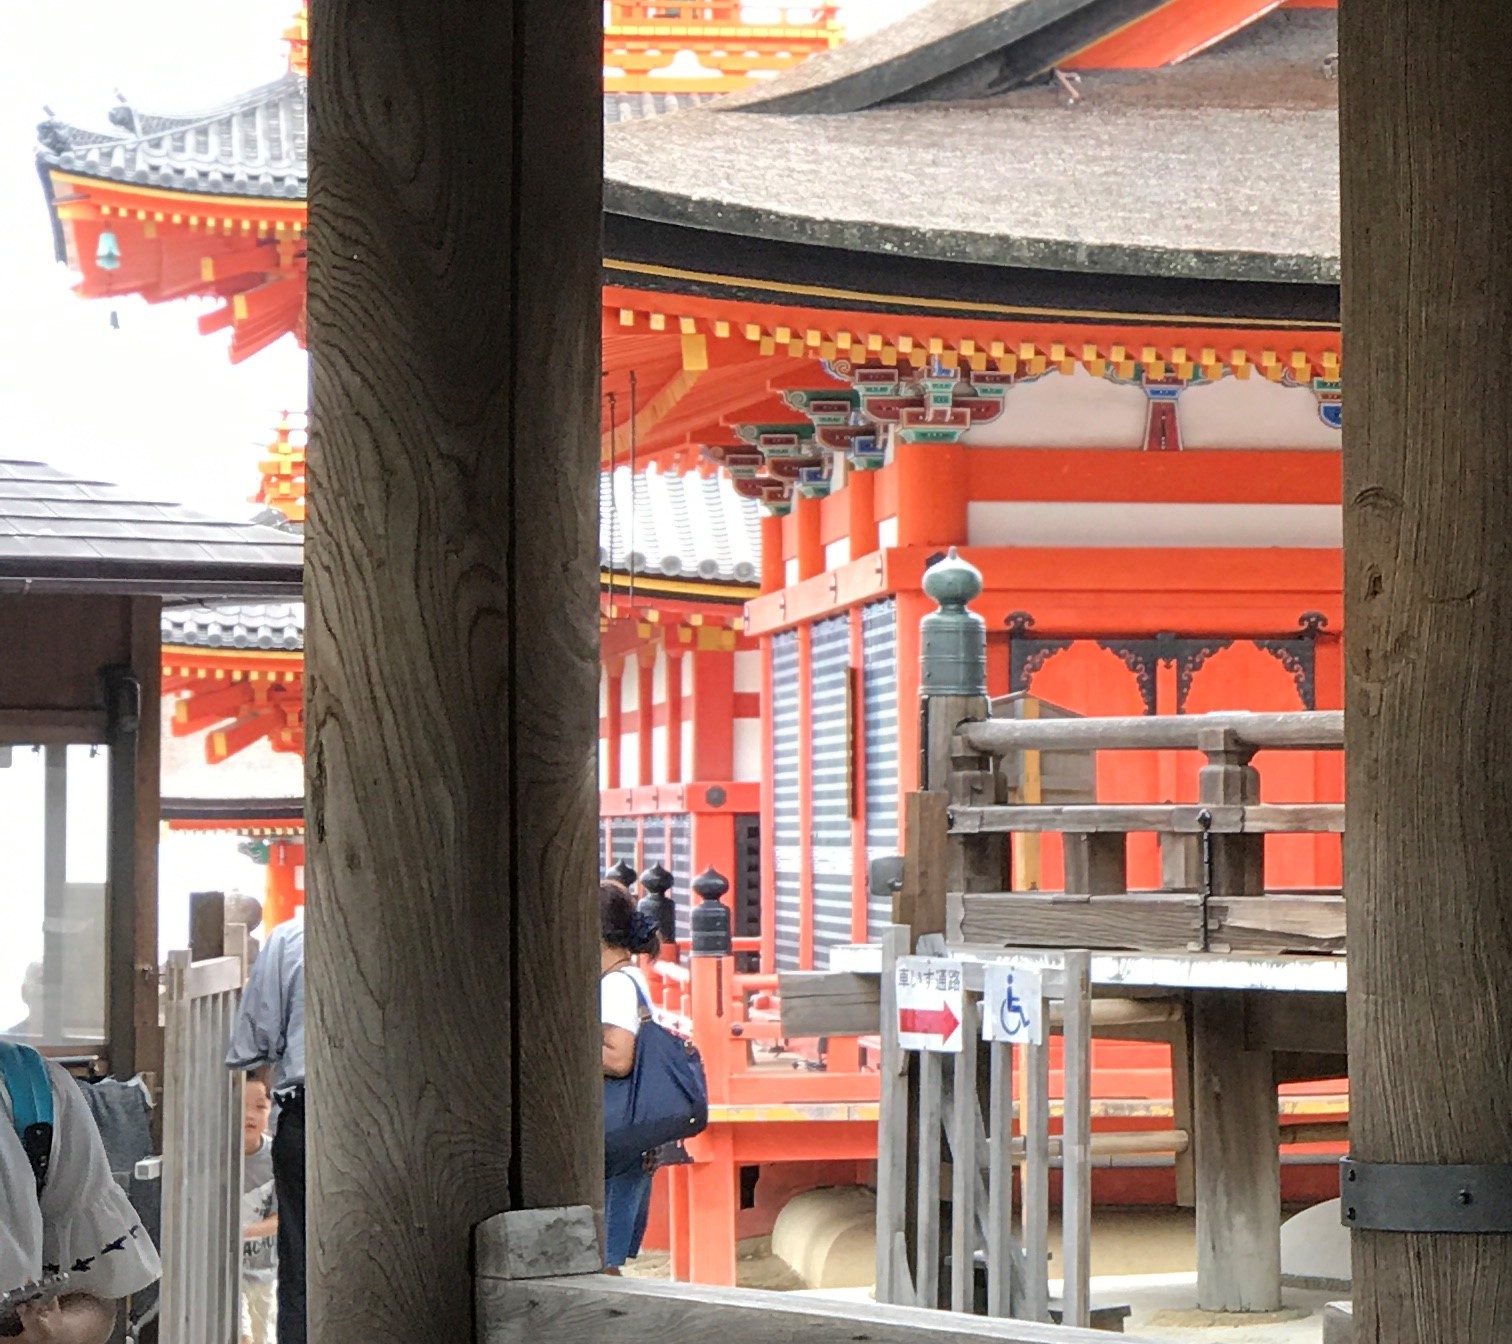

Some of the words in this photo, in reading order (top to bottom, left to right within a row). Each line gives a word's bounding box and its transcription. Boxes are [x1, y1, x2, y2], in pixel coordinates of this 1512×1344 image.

[898, 968, 960, 991] 車いす通路
